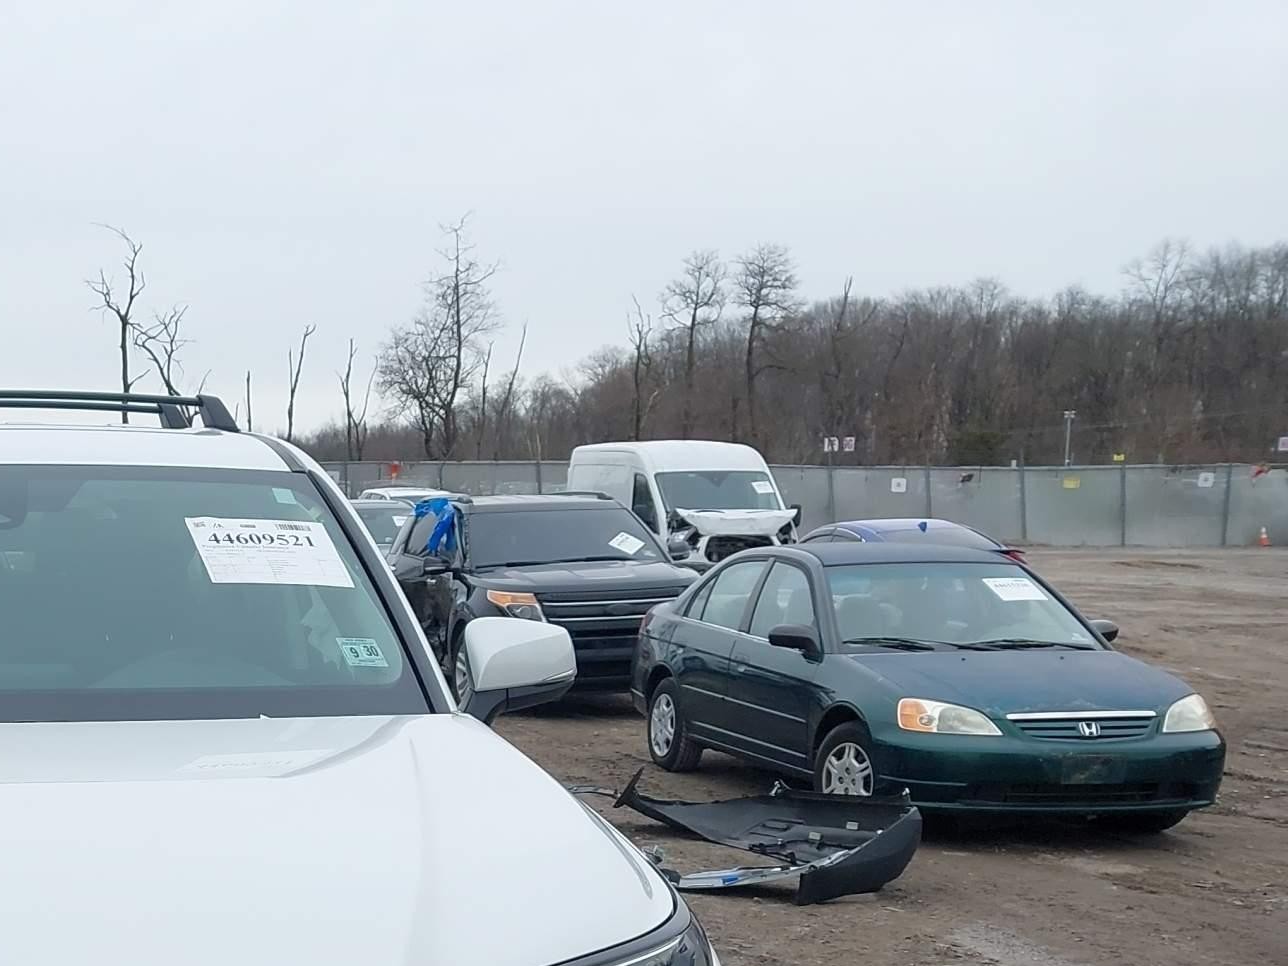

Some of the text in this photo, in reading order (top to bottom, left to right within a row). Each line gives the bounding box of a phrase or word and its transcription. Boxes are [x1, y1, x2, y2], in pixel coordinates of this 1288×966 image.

[208, 532, 315, 548] 44609521
[349, 644, 380, 659] 9 30
